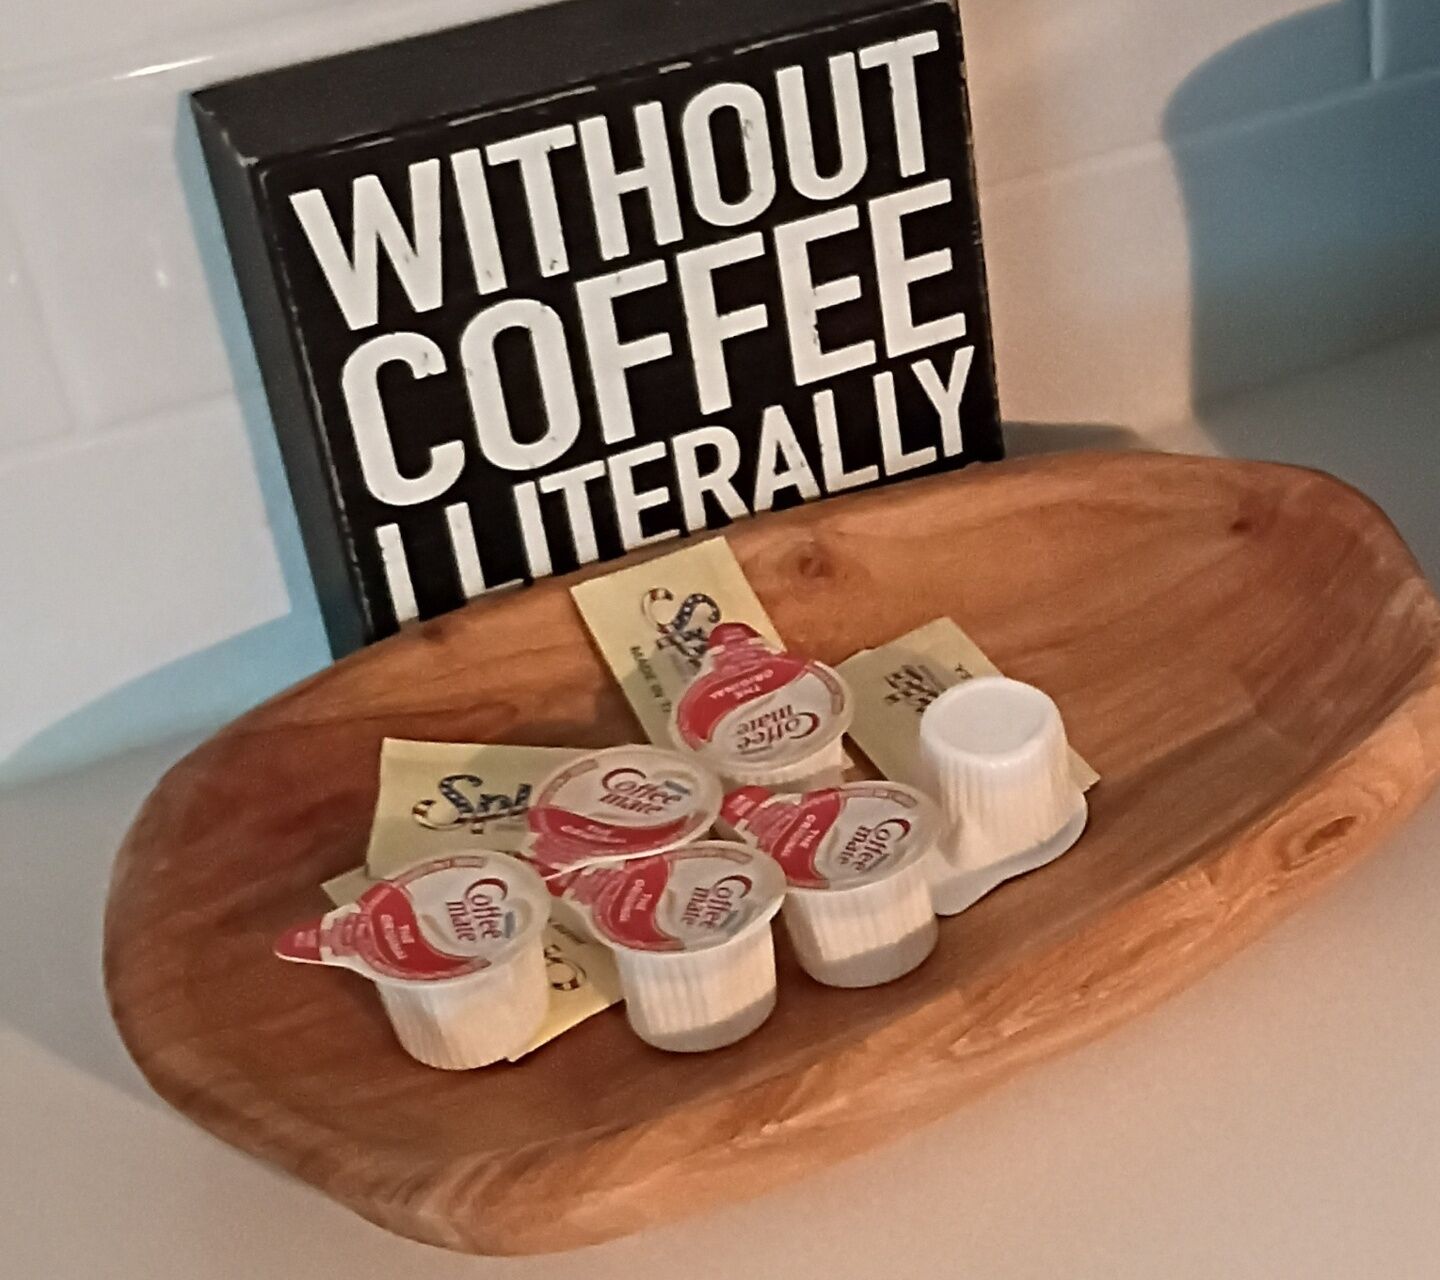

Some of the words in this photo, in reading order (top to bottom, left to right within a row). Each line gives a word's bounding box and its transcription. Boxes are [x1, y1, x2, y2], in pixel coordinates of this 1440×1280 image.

[289, 30, 939, 331] WITHOUT
[341, 178, 966, 506] COFFEE
[375, 523, 420, 623] I
[444, 345, 974, 599] LITERALLY
[737, 704, 795, 735] mate
[737, 712, 820, 750] Coffee
[600, 793, 665, 815] mate
[602, 768, 681, 805] Coffee
[840, 825, 873, 865] mate
[853, 818, 911, 871] Coffee
[446, 900, 476, 941] mate
[465, 878, 508, 940] Coffee
[682, 887, 710, 926] mate
[708, 875, 752, 929] Coffee
